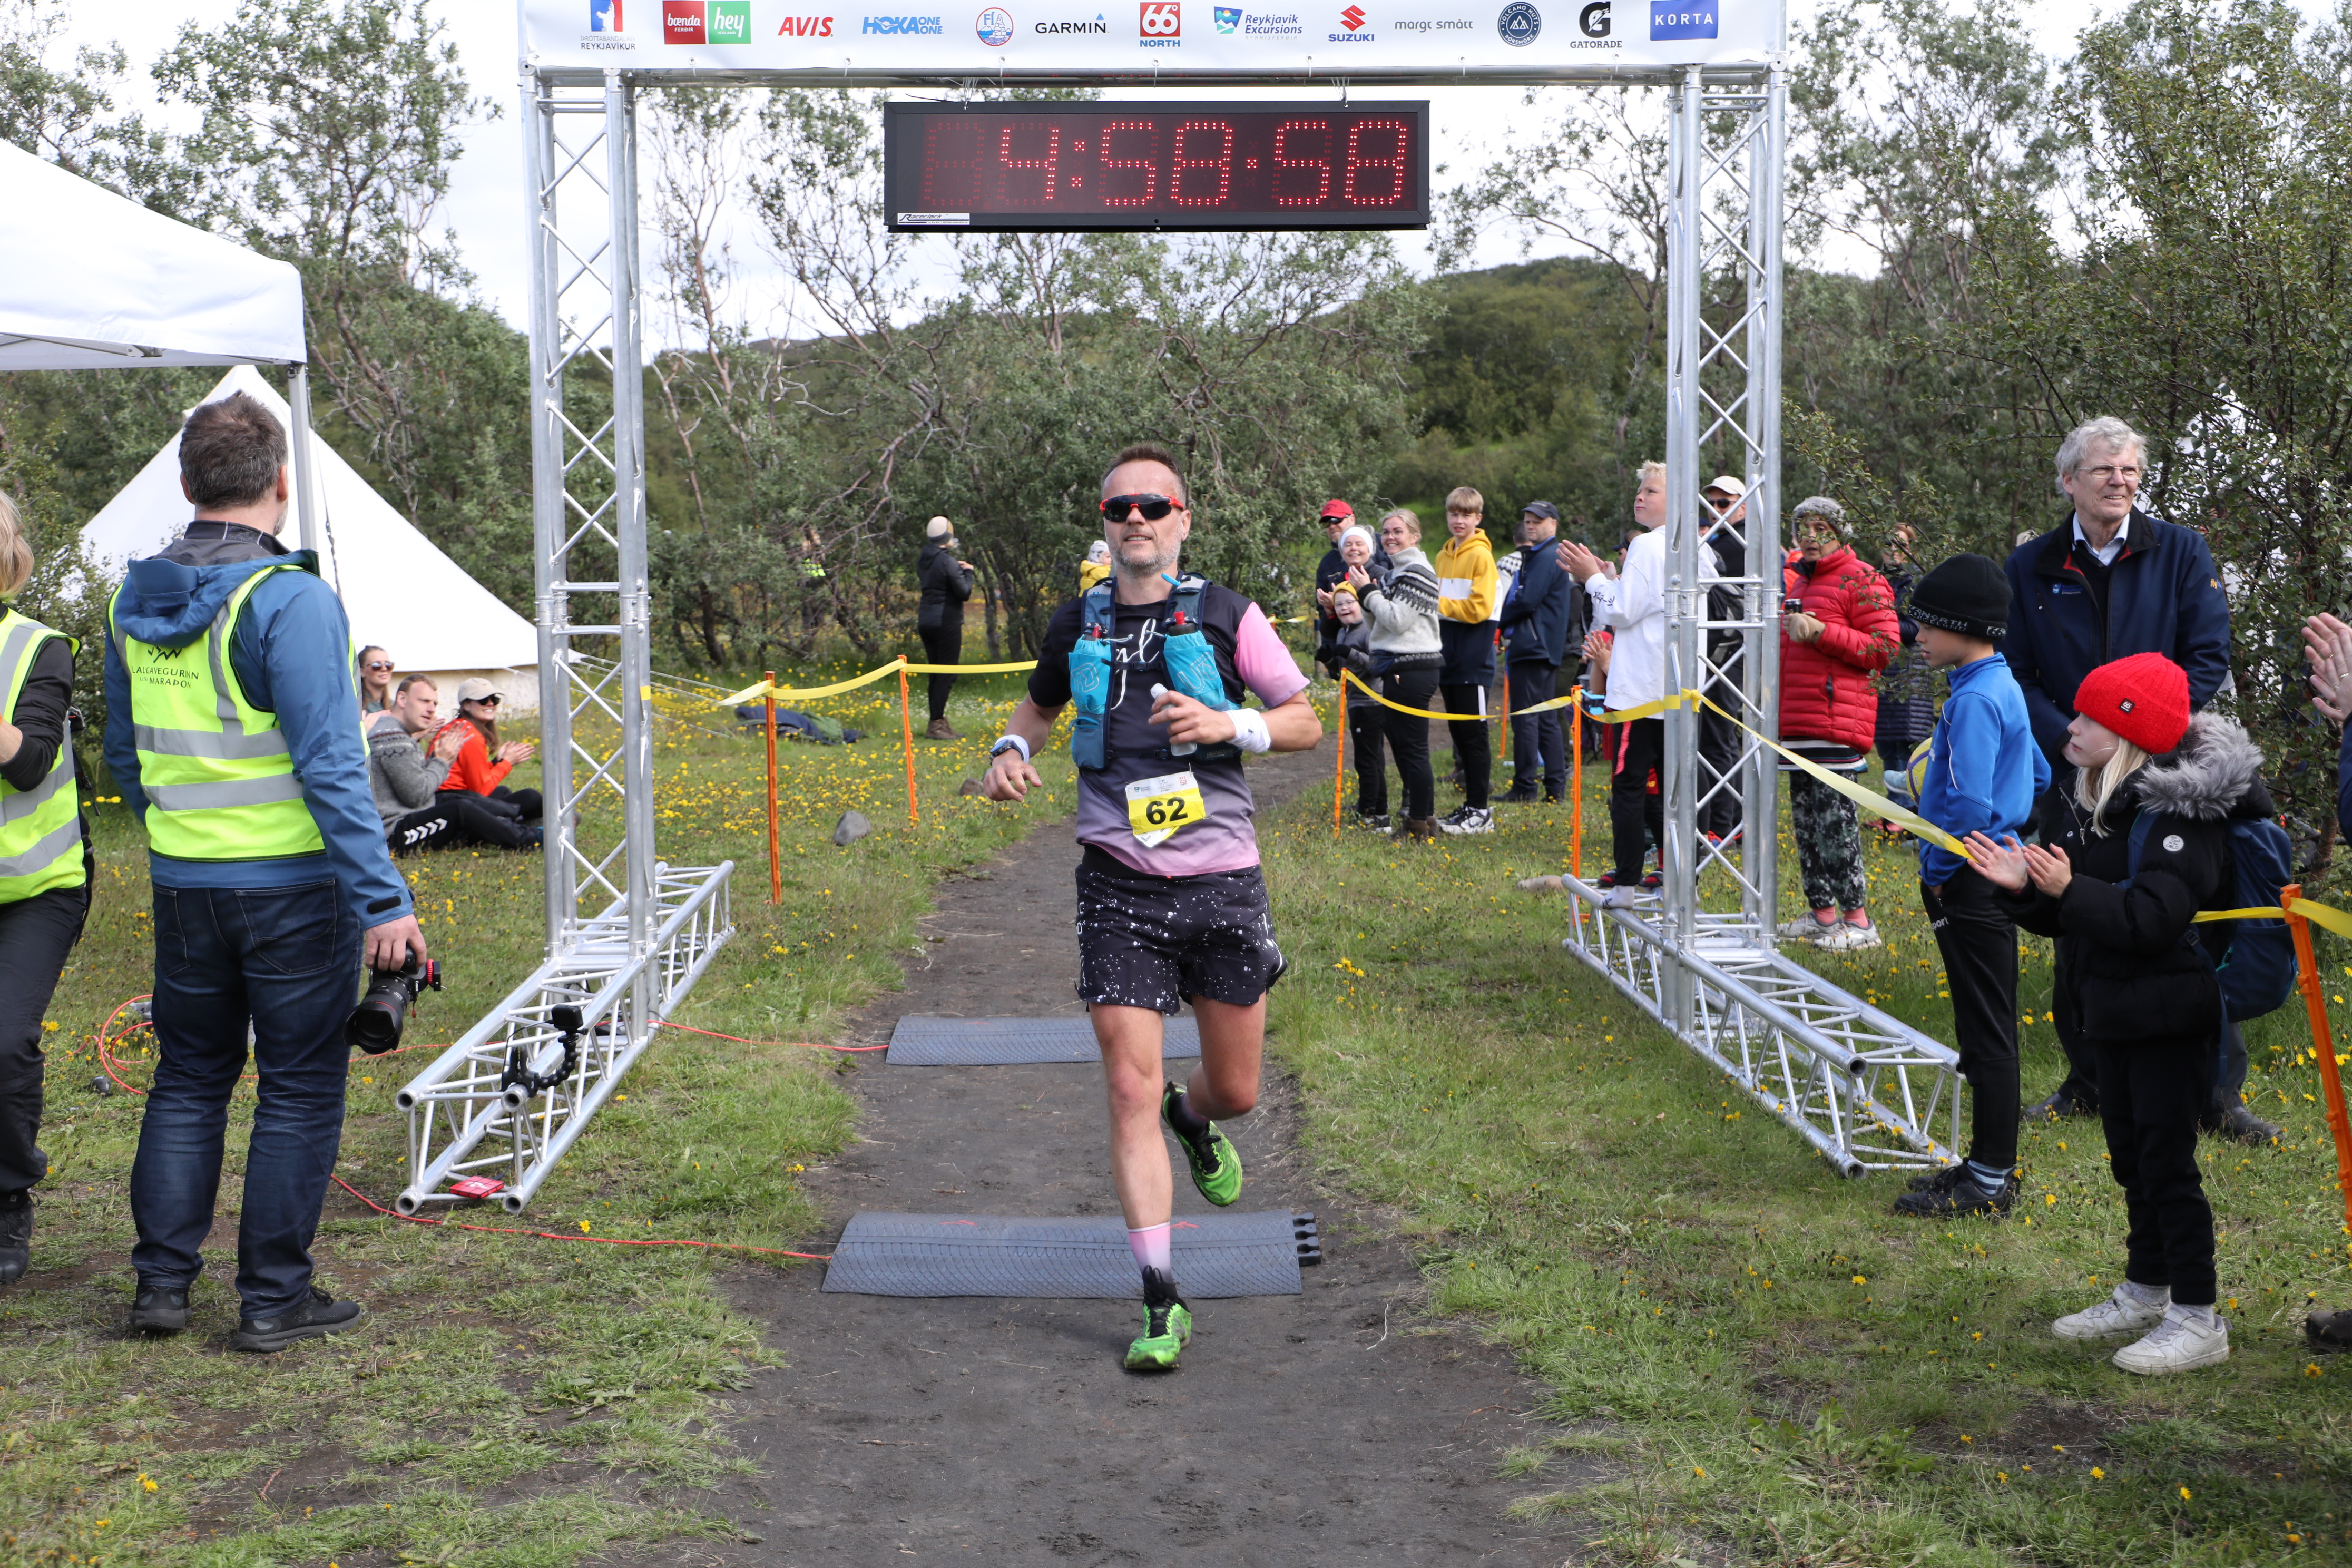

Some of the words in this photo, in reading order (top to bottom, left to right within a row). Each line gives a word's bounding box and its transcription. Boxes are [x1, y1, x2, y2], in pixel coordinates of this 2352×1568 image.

[667, 13, 701, 26] bænda
[918, 17, 941, 25] ONE
[1245, 14, 1298, 26] Reykjavik
[1501, 5, 1526, 25] VOLCANO
[1528, 8, 1538, 25] HUTS
[1655, 13, 1713, 25] KORTA
[714, 7, 744, 38] hey
[778, 17, 834, 37] AVIS
[862, 16, 920, 34] HOKA
[1035, 23, 1106, 33] GARMIN
[1395, 21, 1432, 33] margt
[920, 26, 943, 34] ONE
[1245, 25, 1302, 34] Excursions
[1921, 610, 1968, 628] NORTH
[132, 666, 199, 680] LAUGAVEGURINN
[1146, 796, 1188, 825] 62
